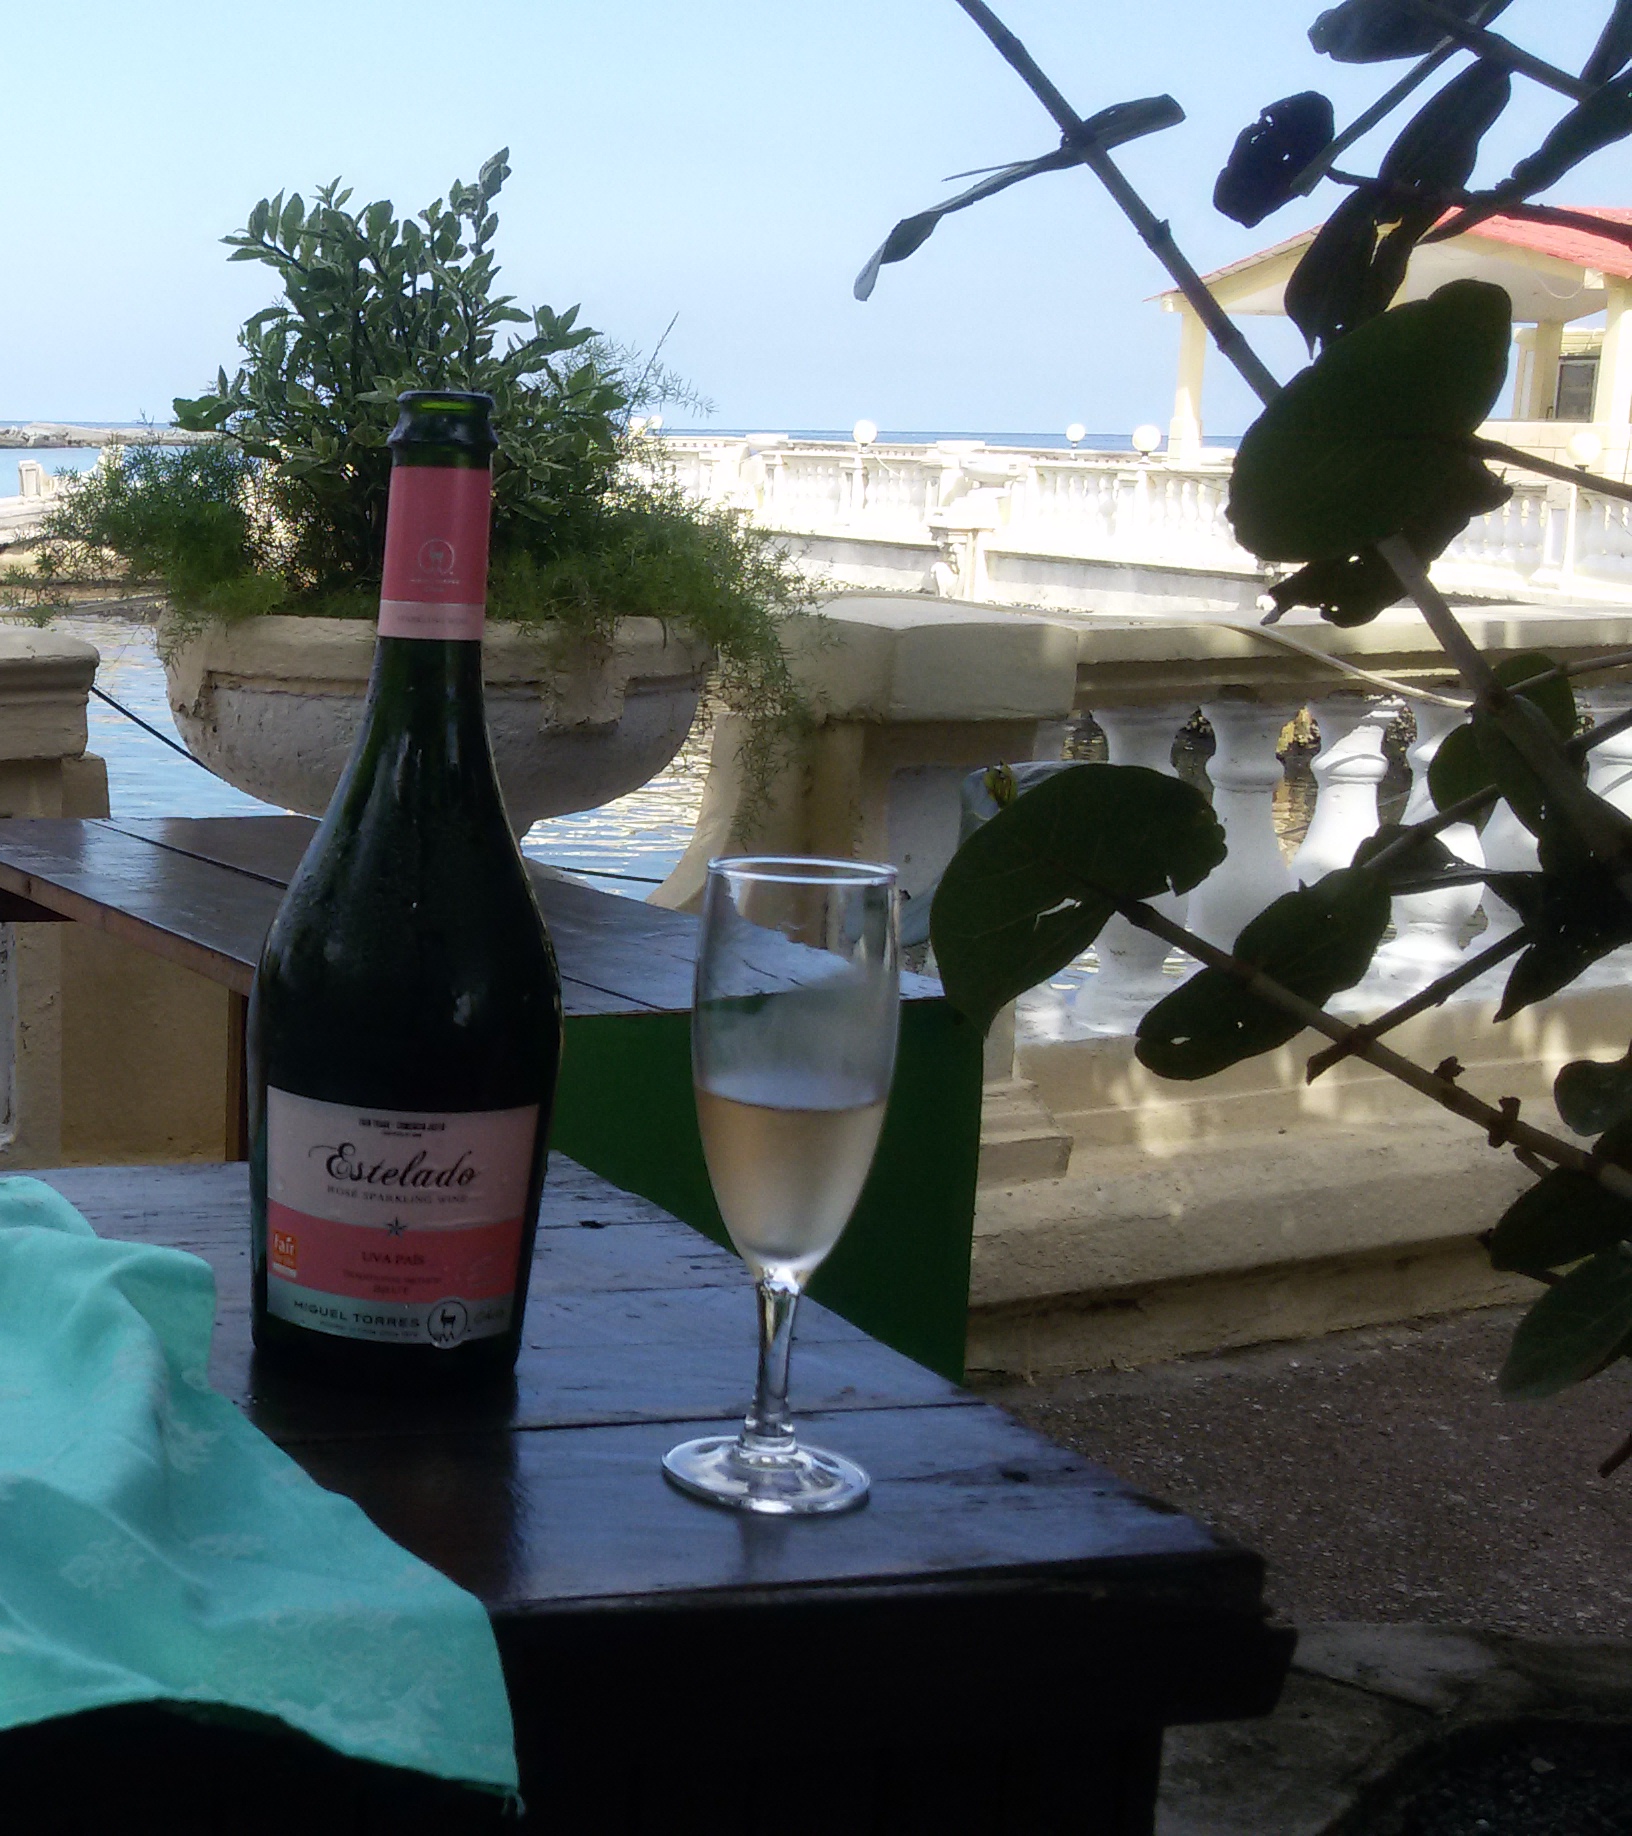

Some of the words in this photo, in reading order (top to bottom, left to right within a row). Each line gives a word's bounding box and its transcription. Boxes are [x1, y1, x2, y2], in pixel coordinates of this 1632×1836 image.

[309, 1142, 478, 1188] Estelado
[293, 1300, 348, 1321] MIGUEL
[352, 1312, 421, 1328] TORRES
